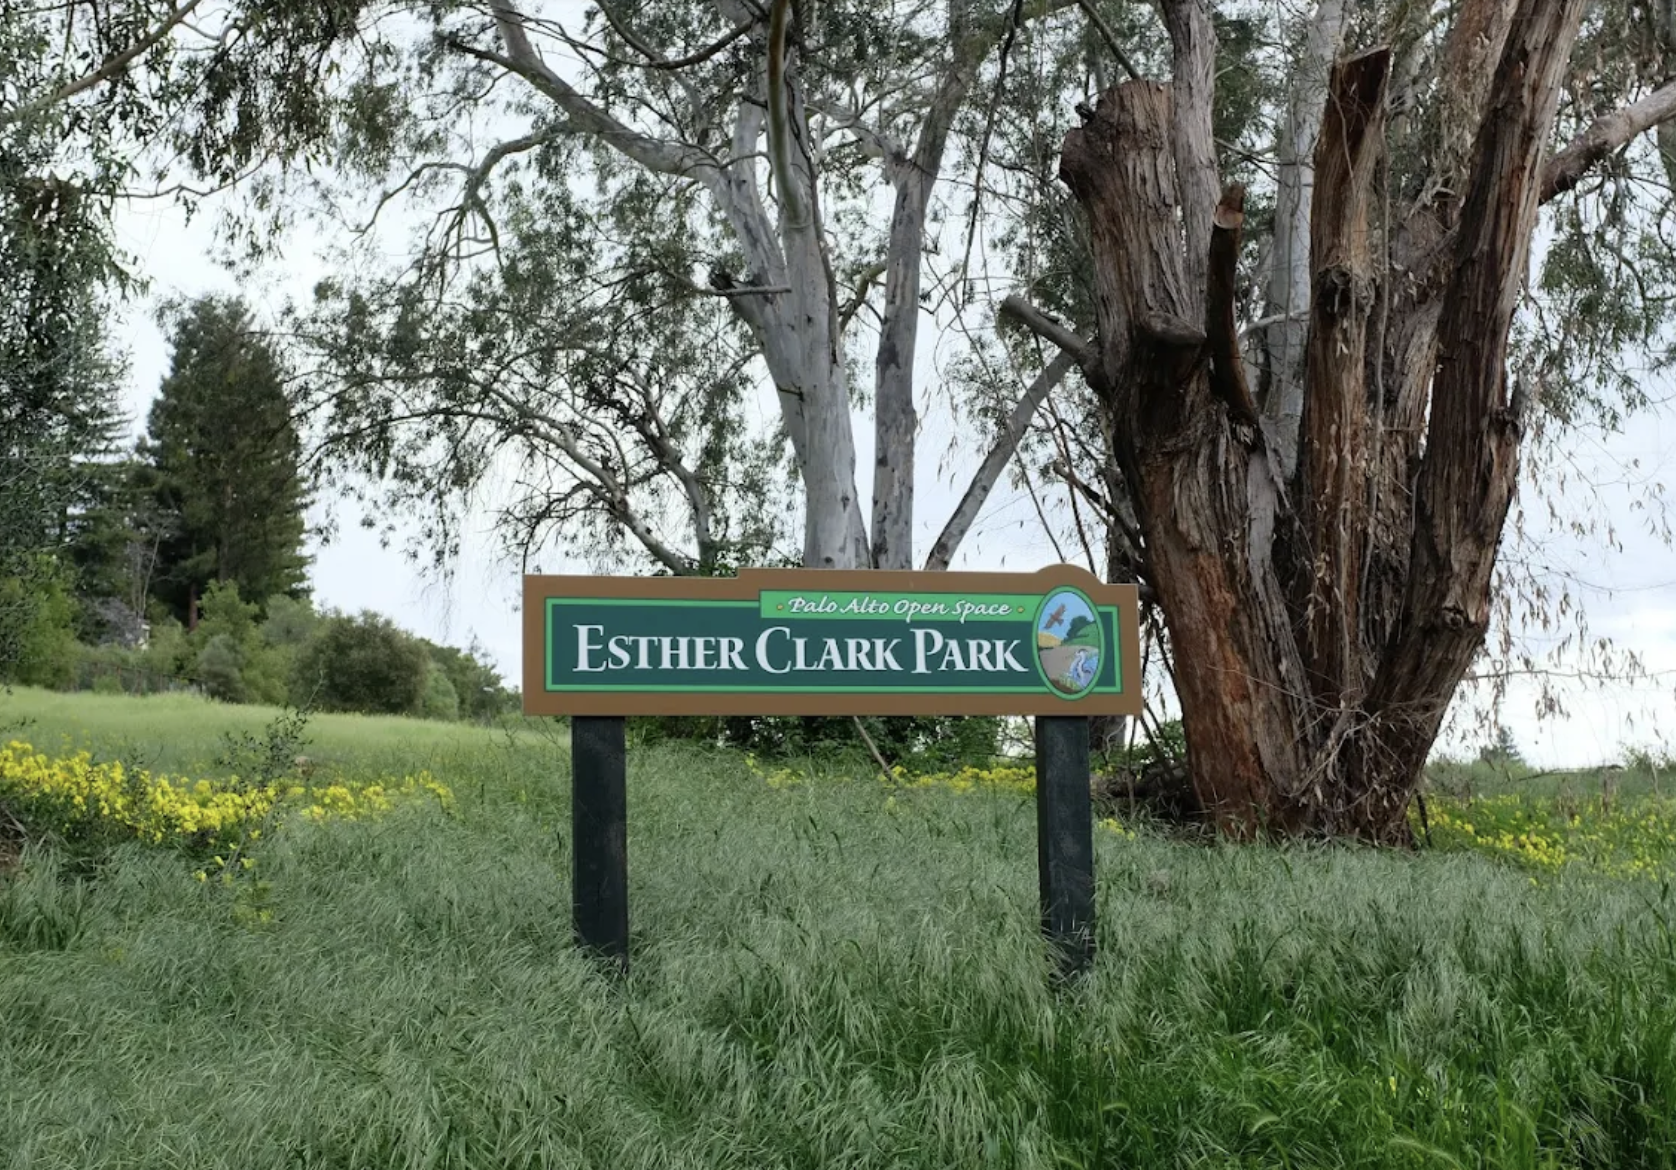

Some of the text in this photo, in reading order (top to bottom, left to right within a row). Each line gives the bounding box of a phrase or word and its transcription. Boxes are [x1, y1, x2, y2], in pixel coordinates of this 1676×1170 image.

[788, 596, 1011, 624] Palo Alto Open Space
[572, 624, 1029, 674] ESTHER CLARK PARK
